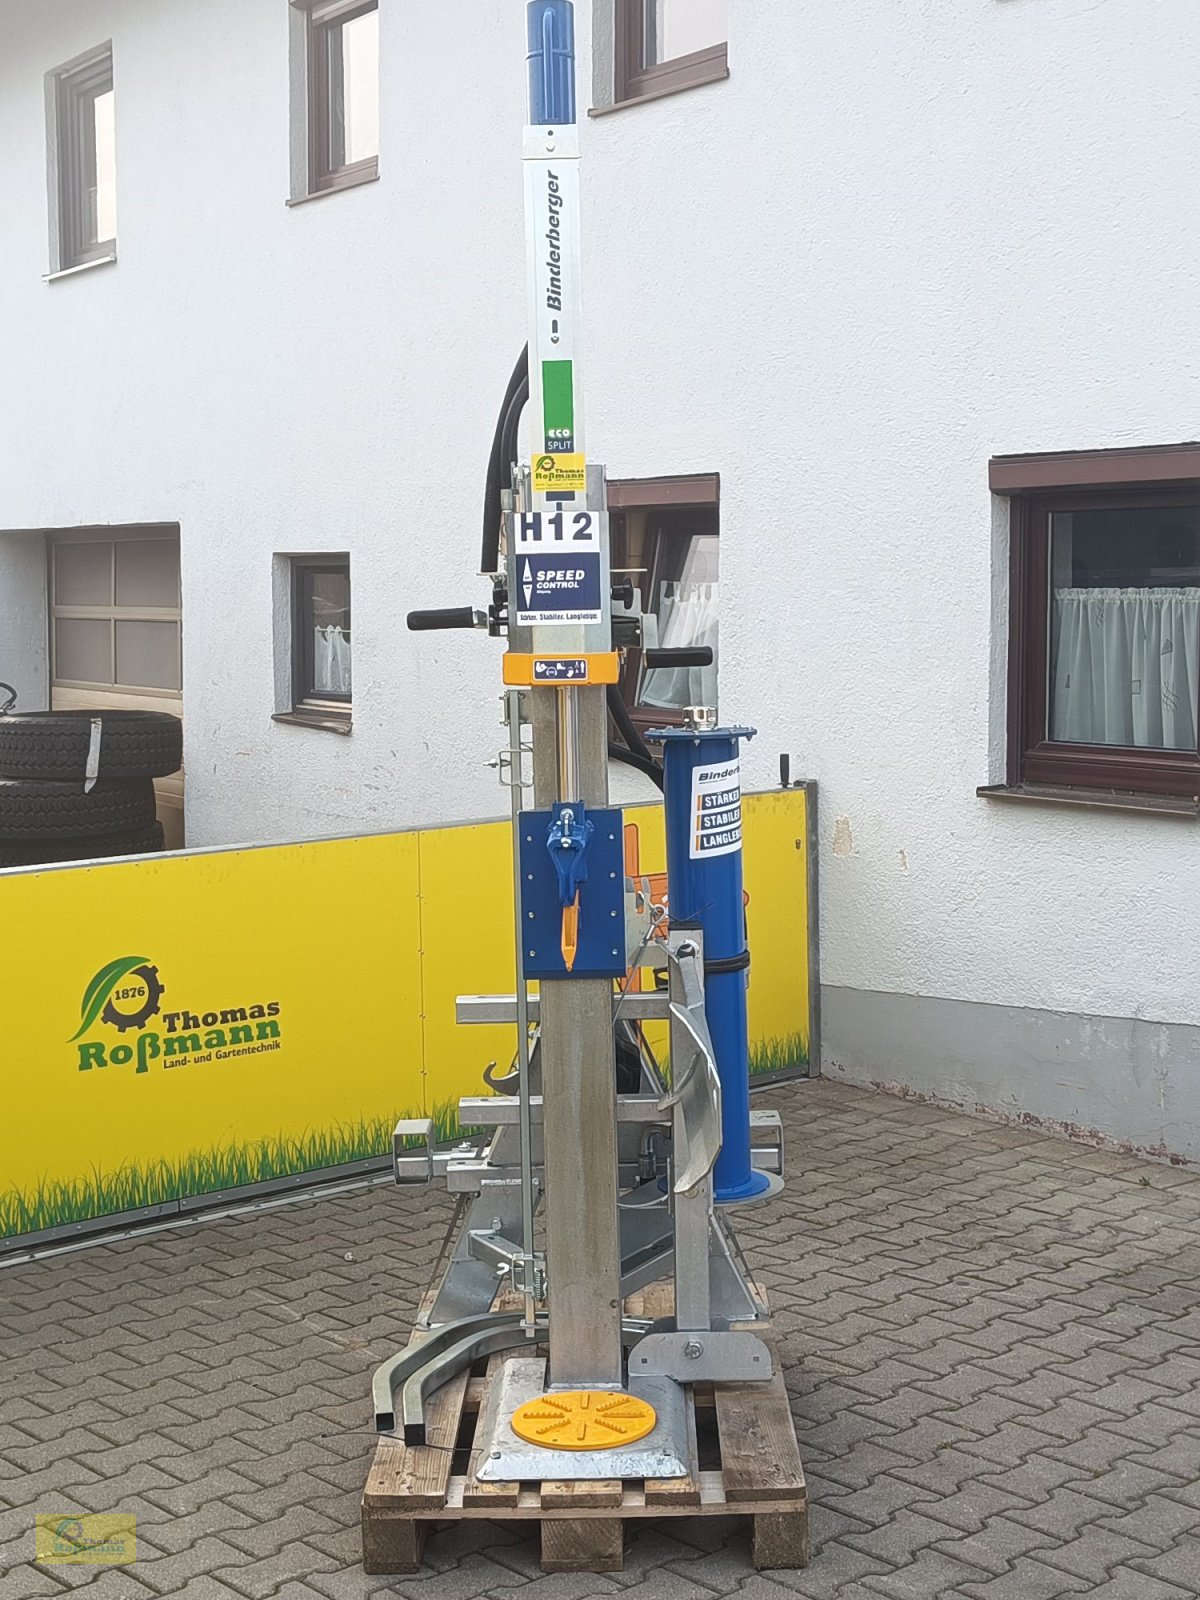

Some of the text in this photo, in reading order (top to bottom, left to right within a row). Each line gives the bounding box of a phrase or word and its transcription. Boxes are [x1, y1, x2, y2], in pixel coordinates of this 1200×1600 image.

[546, 169, 563, 312] Binderberger
[548, 429, 570, 438] eco
[547, 441, 572, 450] SPLIT
[520, 512, 593, 542] H12
[536, 569, 585, 581] SPEED
[536, 581, 580, 589] CONTROL
[114, 986, 146, 1001] 1876
[162, 1001, 280, 1033] Thomas
[77, 1019, 281, 1074] Roßmann
[163, 1040, 281, 1069] Land- und Gartentechnik
